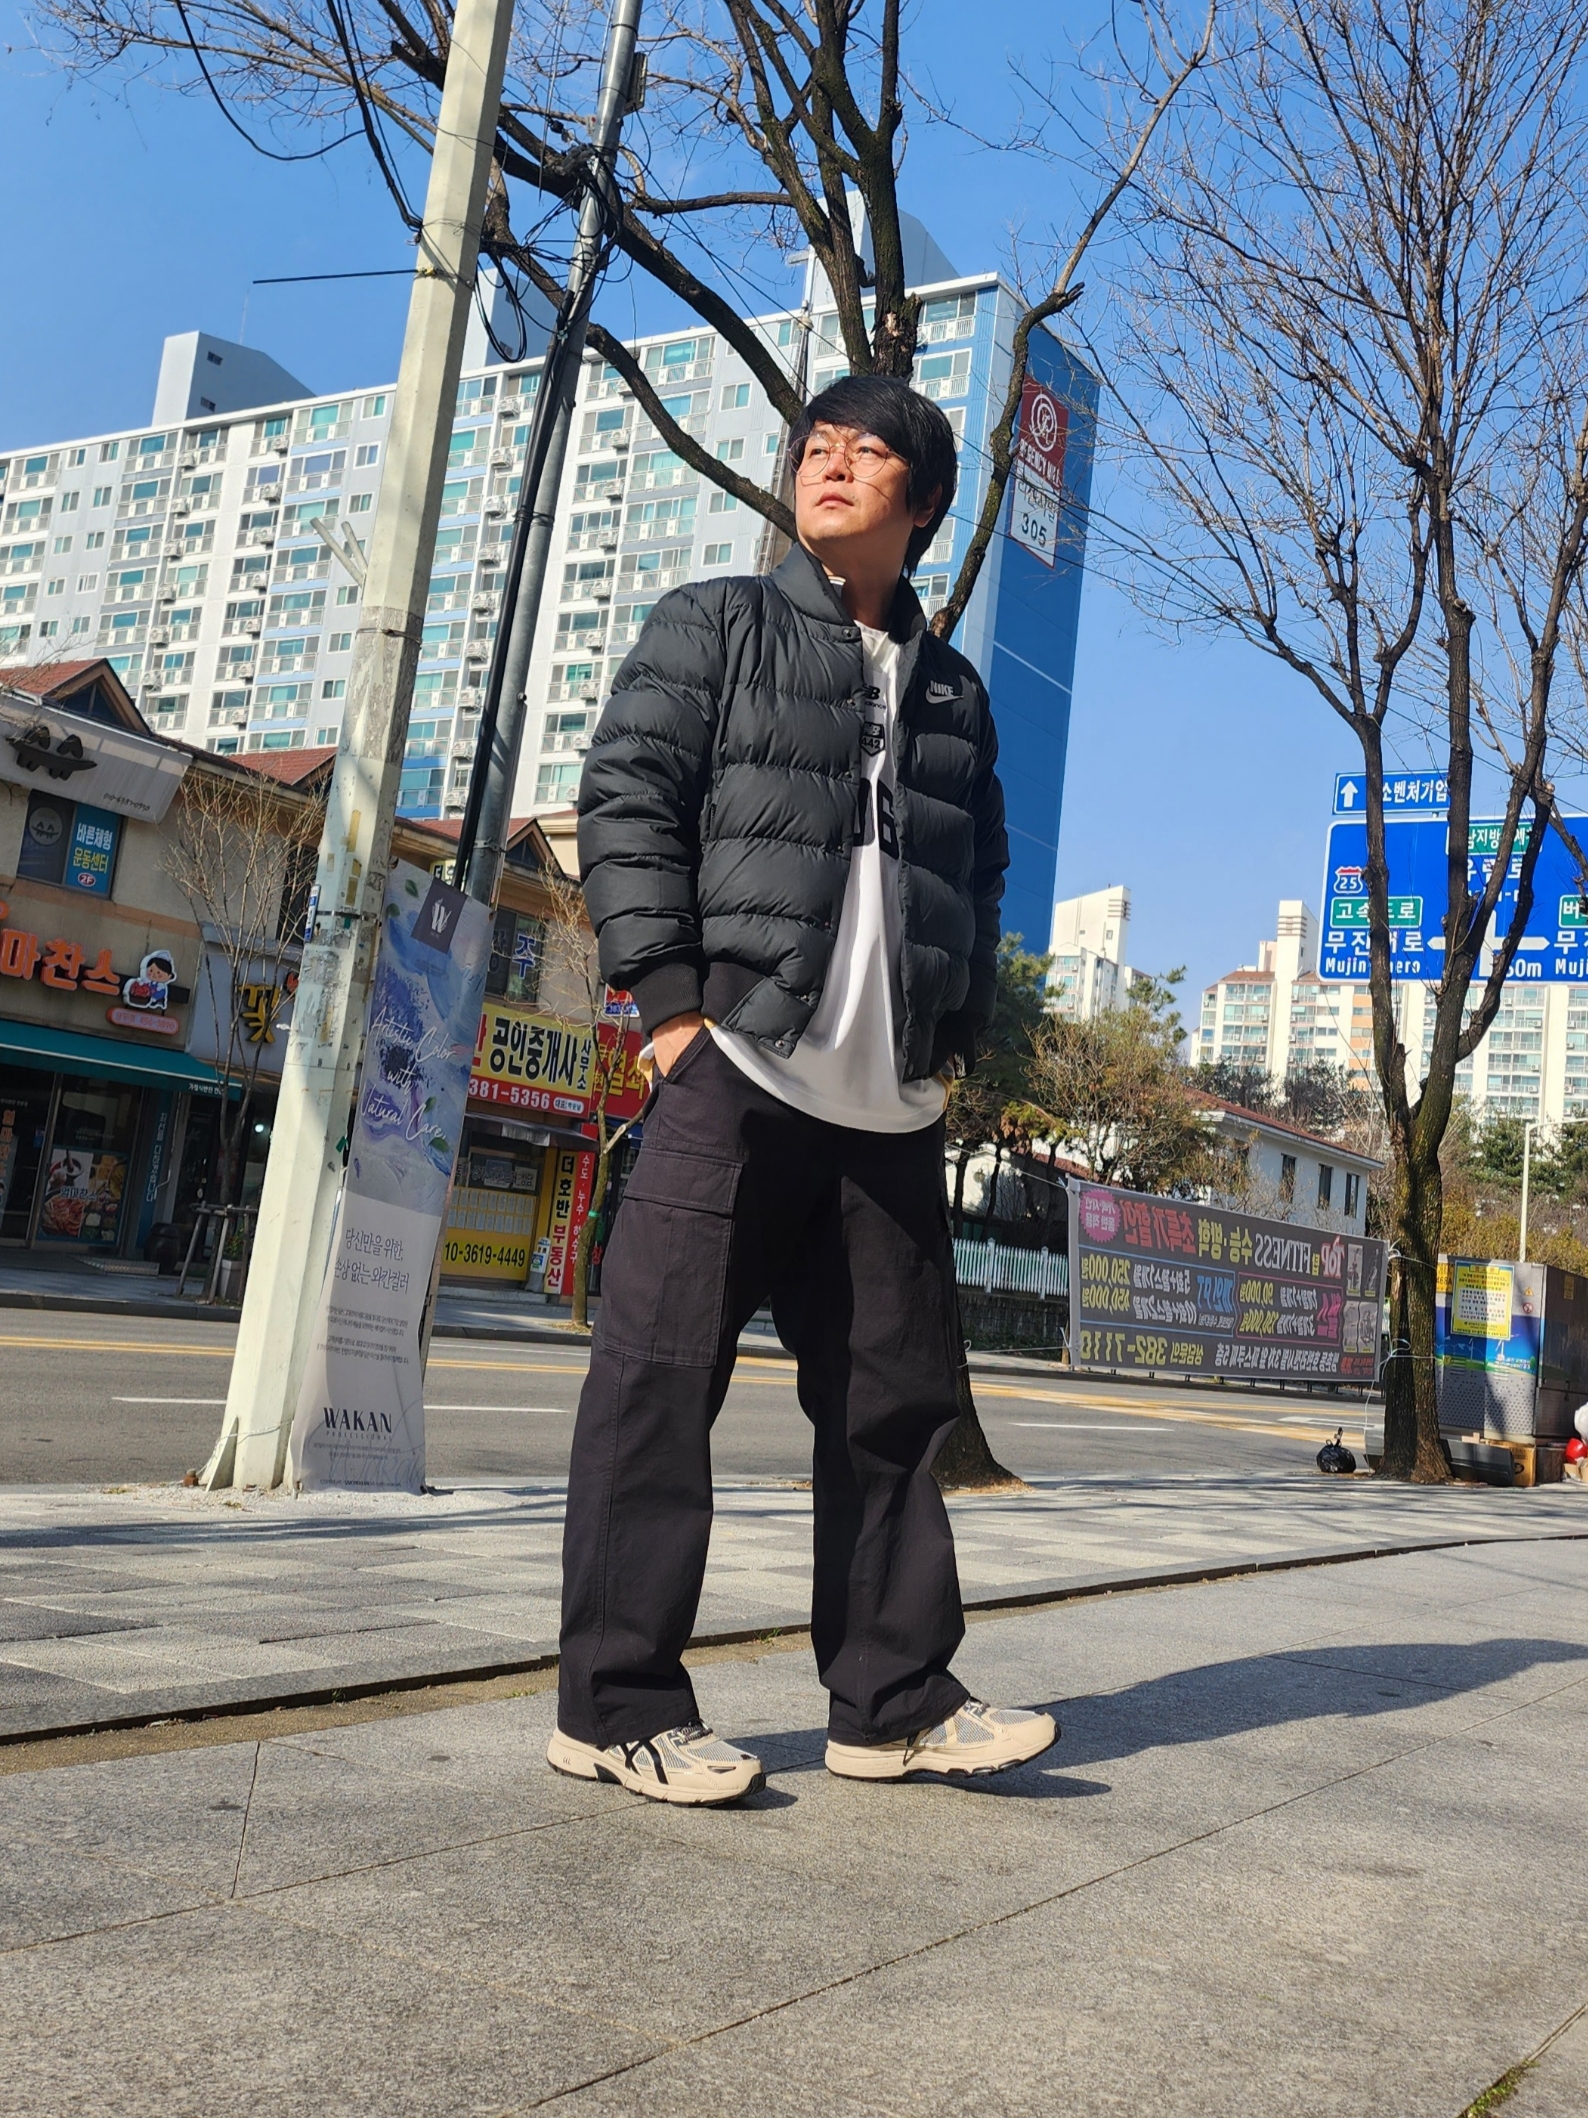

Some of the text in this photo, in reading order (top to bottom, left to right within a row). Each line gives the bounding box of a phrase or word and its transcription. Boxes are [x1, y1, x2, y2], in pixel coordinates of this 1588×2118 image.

[1022, 512, 1047, 548] 305
[930, 680, 954, 695] NIKE
[862, 736, 882, 748] 442
[1382, 779, 1449, 803] 소벤처기업
[76, 822, 113, 851] 바른체형
[73, 847, 109, 873] 운동센터
[81, 875, 93, 885] 2F
[1339, 877, 1357, 889] 25
[511, 933, 536, 979] 주
[1325, 957, 1421, 976] Mujinero
[237, 982, 281, 1043] 꽃
[369, 1006, 414, 1046] Artistic
[415, 1026, 456, 1062] Color
[489, 1016, 578, 1087] 공인중개사
[576, 1038, 592, 1092] 사무소
[387, 1061, 417, 1095] with
[361, 1083, 409, 1126] Natural
[468, 1078, 550, 1110] 381-5356
[345, 1228, 383, 1256] 당신만을
[445, 1242, 526, 1268] 10-3619-4449
[546, 1224, 566, 1288] 부동산
[351, 1261, 371, 1285] 없는
[371, 1266, 410, 1294] 와칸컬러
[323, 1407, 392, 1434] WAKAN
[326, 1431, 393, 1442] PROFESSIONAL
